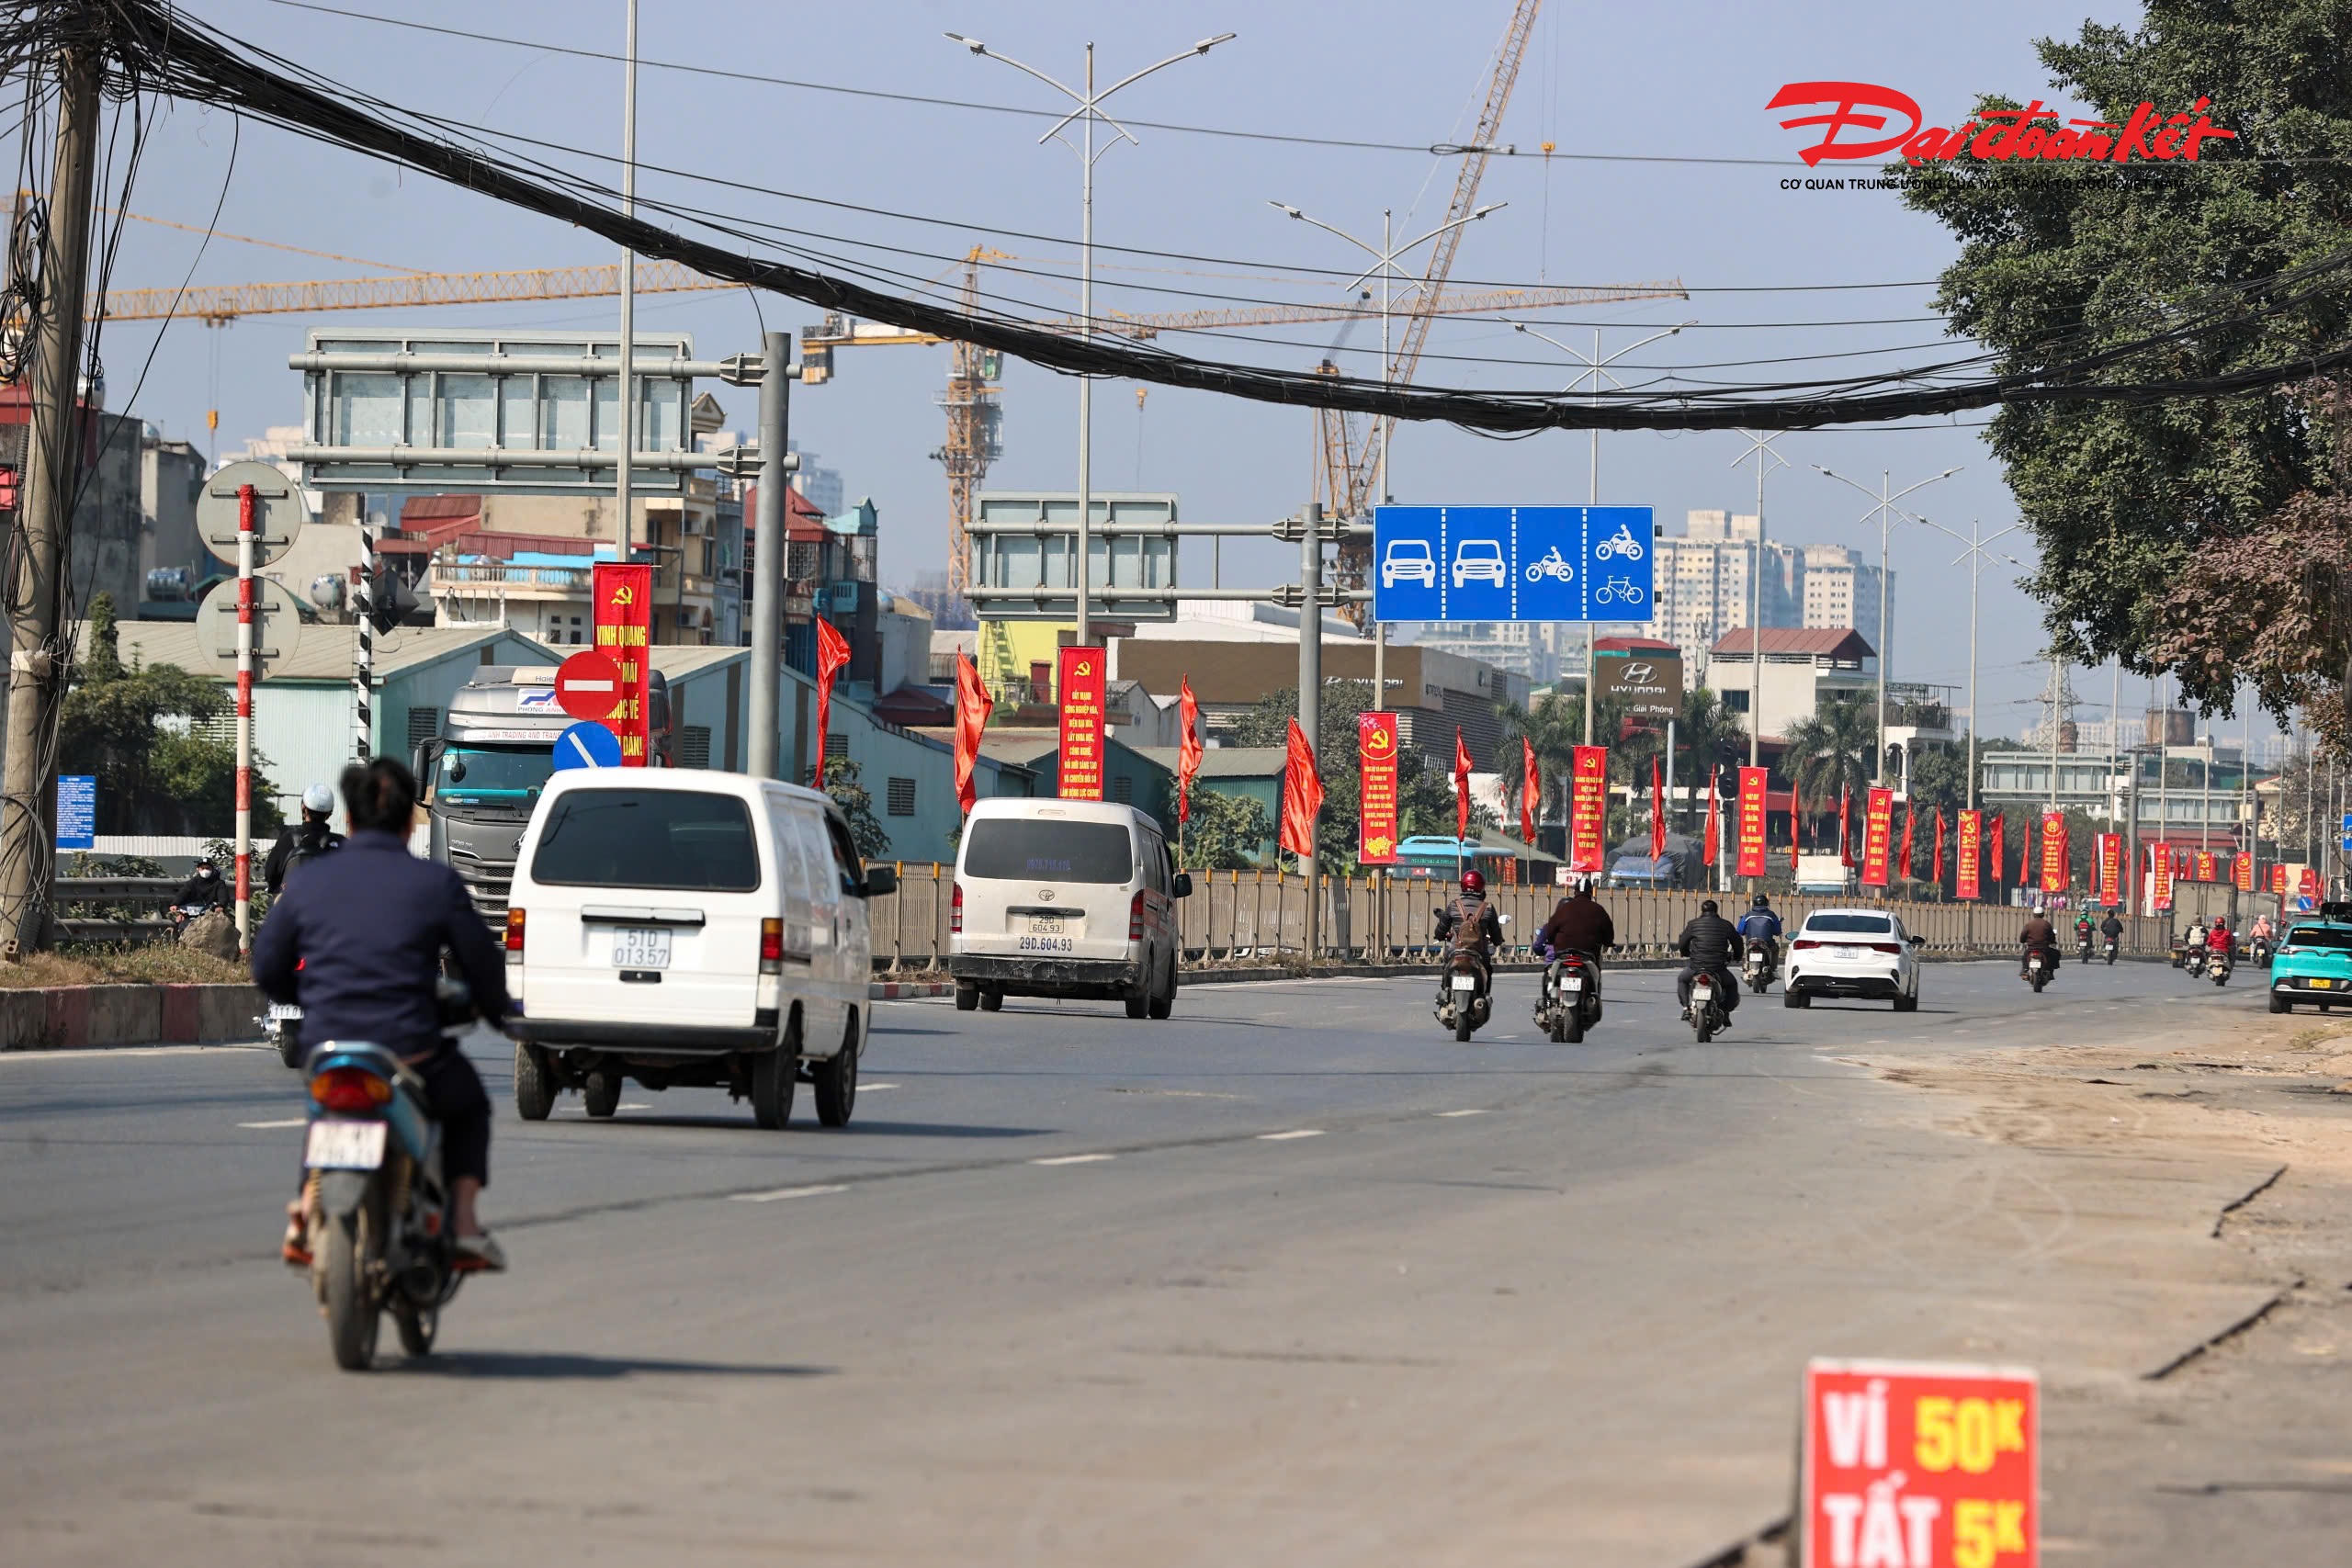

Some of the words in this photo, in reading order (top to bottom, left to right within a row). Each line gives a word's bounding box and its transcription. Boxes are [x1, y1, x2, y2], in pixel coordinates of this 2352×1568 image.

[597, 625, 616, 646] VINH
[618, 625, 646, 649] QUANG
[629, 693, 639, 720] VỀ
[1649, 705, 1674, 716] Phóng
[623, 731, 643, 757] DÂN!
[1039, 916, 1055, 924] 29D
[628, 929, 657, 947] 51D
[1020, 936, 1072, 952] 29D.604.93
[1823, 1378, 1889, 1469] VÍ
[1823, 1469, 1941, 1568] TẤT
